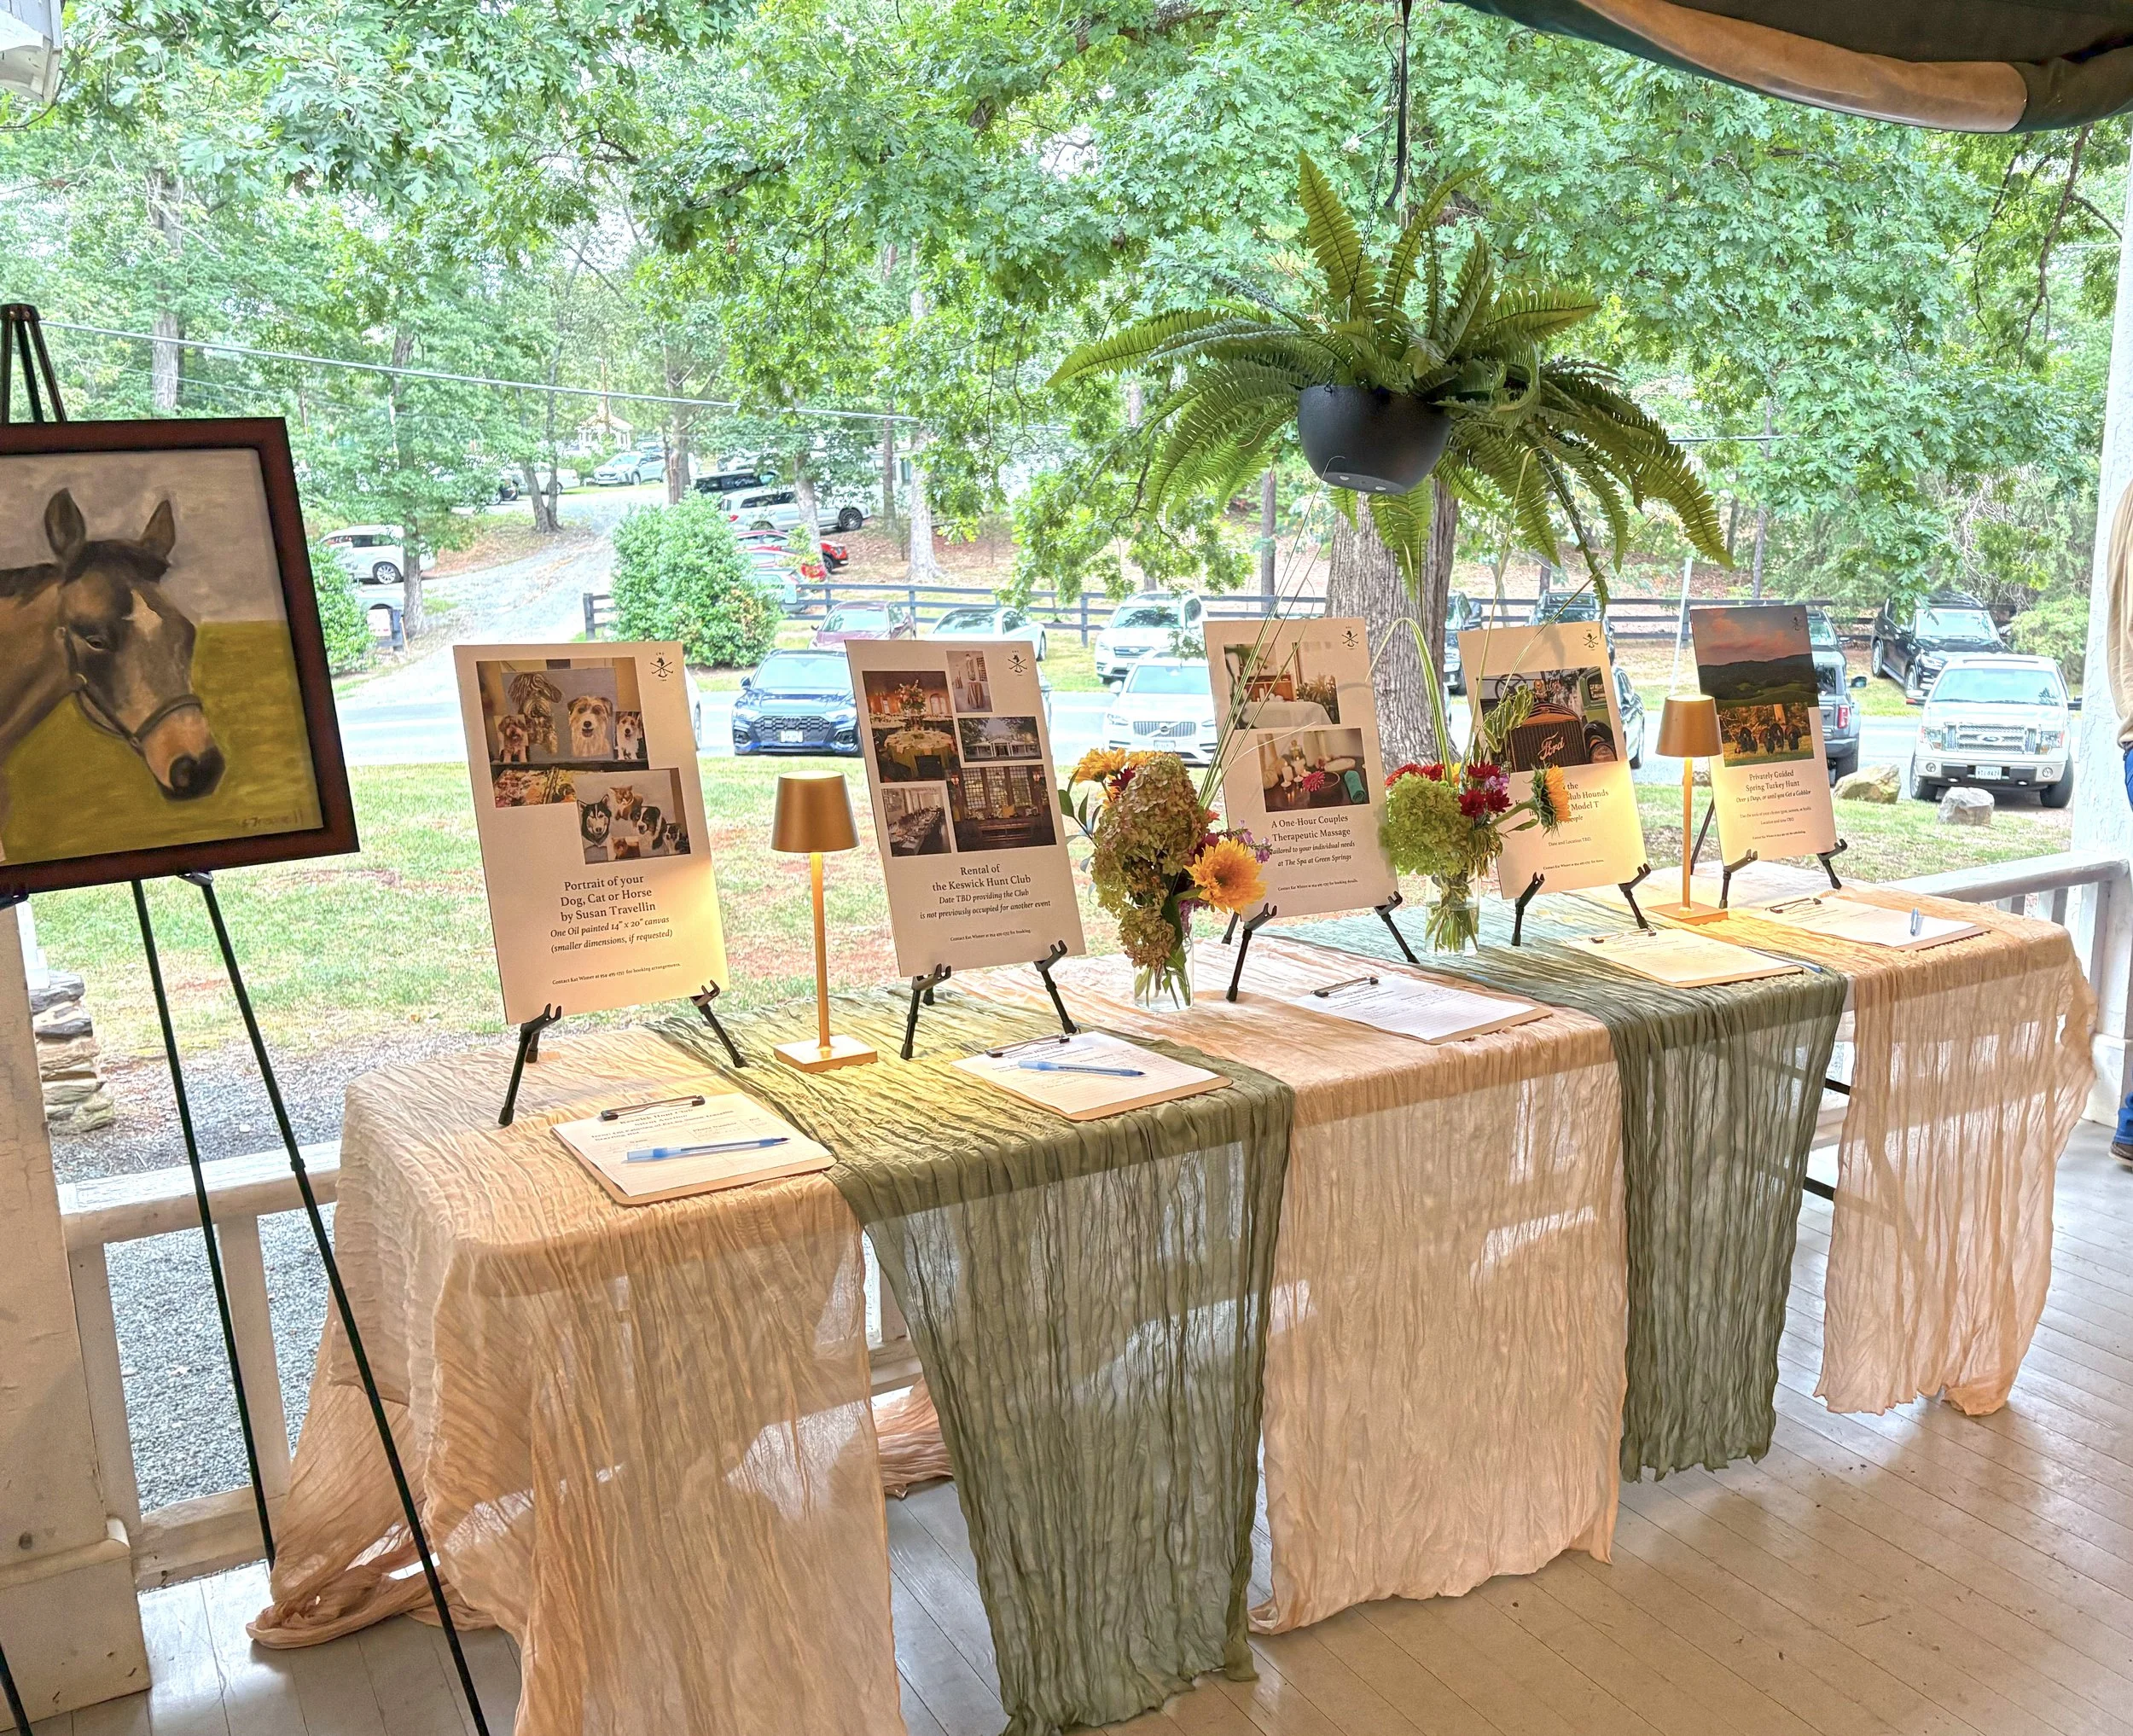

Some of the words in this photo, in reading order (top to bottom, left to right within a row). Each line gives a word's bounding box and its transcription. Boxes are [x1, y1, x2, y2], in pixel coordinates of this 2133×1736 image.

[1537, 731, 1565, 760] Ford
[1749, 772, 1773, 781] Privately
[1775, 769, 1794, 778] Guided
[1583, 789, 1608, 798] Hounds
[1571, 802, 1592, 810] Model
[1279, 817, 1316, 827] One-Hour
[1318, 815, 1348, 824] Couples
[1272, 832, 1318, 842] Therapeutic
[1320, 828, 1351, 837] Massage
[1299, 845, 1311, 854] your
[1313, 841, 1340, 851] individual
[1332, 854, 1351, 862] Springs
[961, 865, 989, 875] Rental
[991, 864, 1000, 874] of
[564, 879, 604, 891] Portrait
[607, 876, 618, 885] of
[620, 875, 644, 887] your
[933, 882, 947, 891] the
[949, 878, 985, 890] Keswick
[987, 877, 1008, 886] Hunt
[1010, 874, 1031, 885] Club
[561, 897, 585, 908] Dog,
[588, 894, 606, 903] Cat
[622, 889, 652, 900] Horse
[973, 891, 1002, 902] providing
[561, 912, 573, 924] by
[576, 908, 607, 920] Susan
[609, 903, 655, 915] Travellin
[939, 909, 971, 919] previously
[973, 904, 999, 914] occupied
[1000, 904, 1008, 913] for
[1010, 902, 1033, 910] another
[550, 929, 566, 938] One
[567, 926, 579, 936] Oil
[581, 923, 608, 936] painted
[644, 916, 669, 926] canvas
[550, 943, 582, 954] (smaller
[584, 937, 627, 949] dimensions,
[629, 934, 636, 943] if
[636, 929, 673, 943] requested)
